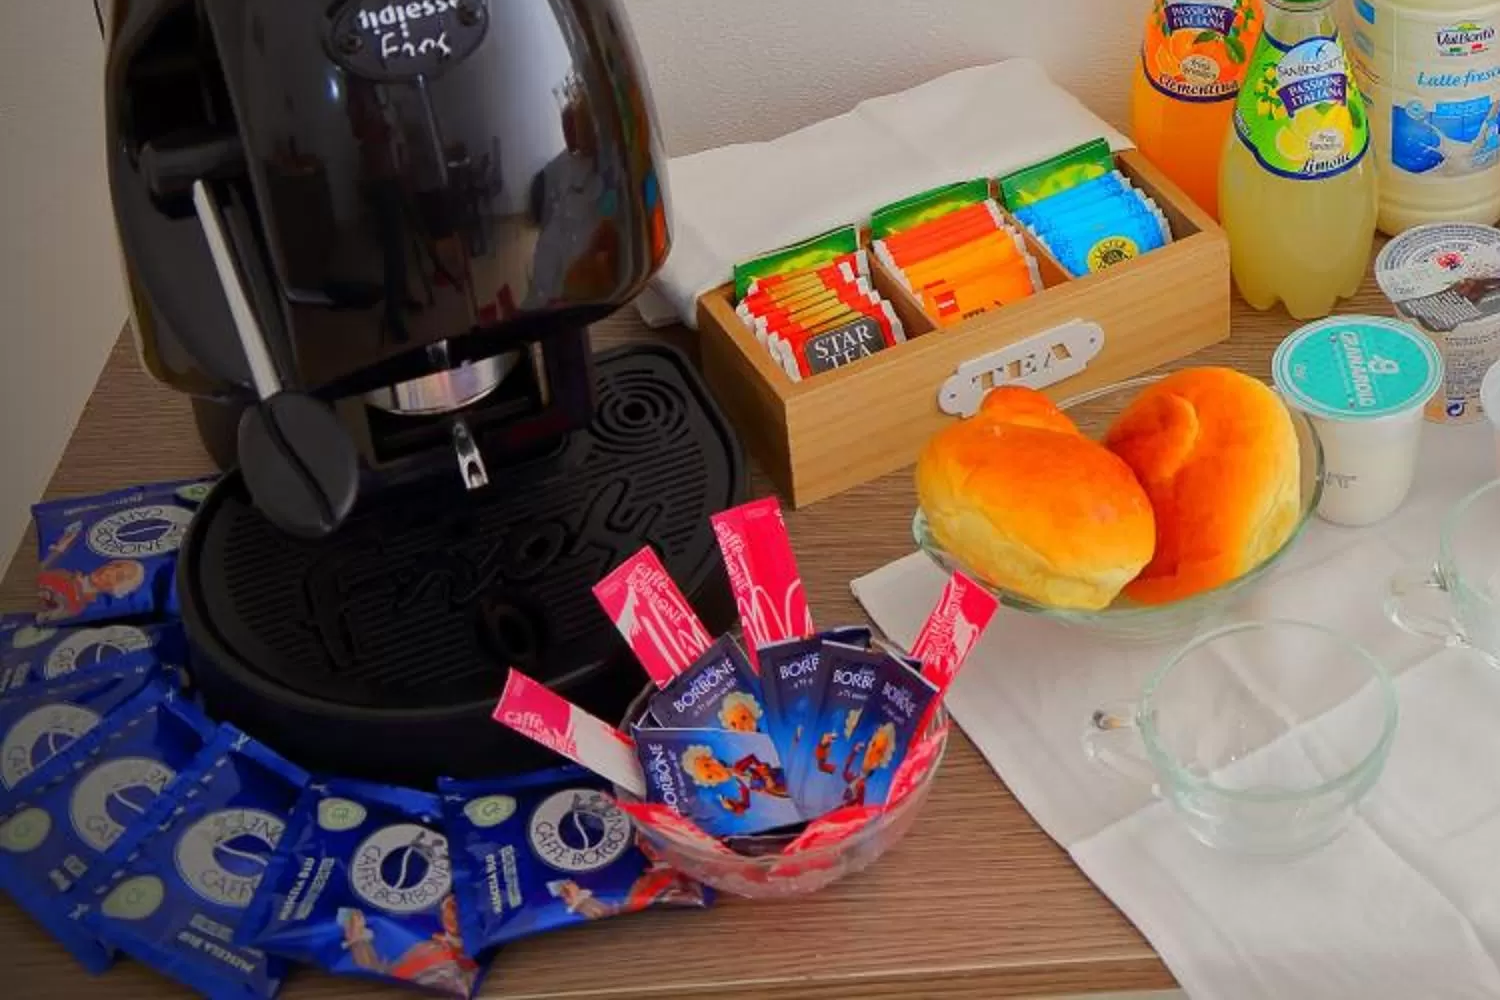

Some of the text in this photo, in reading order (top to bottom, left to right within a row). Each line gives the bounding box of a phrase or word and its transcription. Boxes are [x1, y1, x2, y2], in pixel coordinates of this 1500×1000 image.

[1171, 5, 1228, 20] PASSIONE
[1287, 75, 1343, 96] PASSIONE
[1417, 71, 1464, 88] Latte
[1290, 86, 1344, 107] ITALIANA
[1302, 152, 1351, 174] Limone
[813, 324, 874, 353] STAR
[825, 347, 875, 367] TEA
[673, 658, 736, 713] BORBONE
